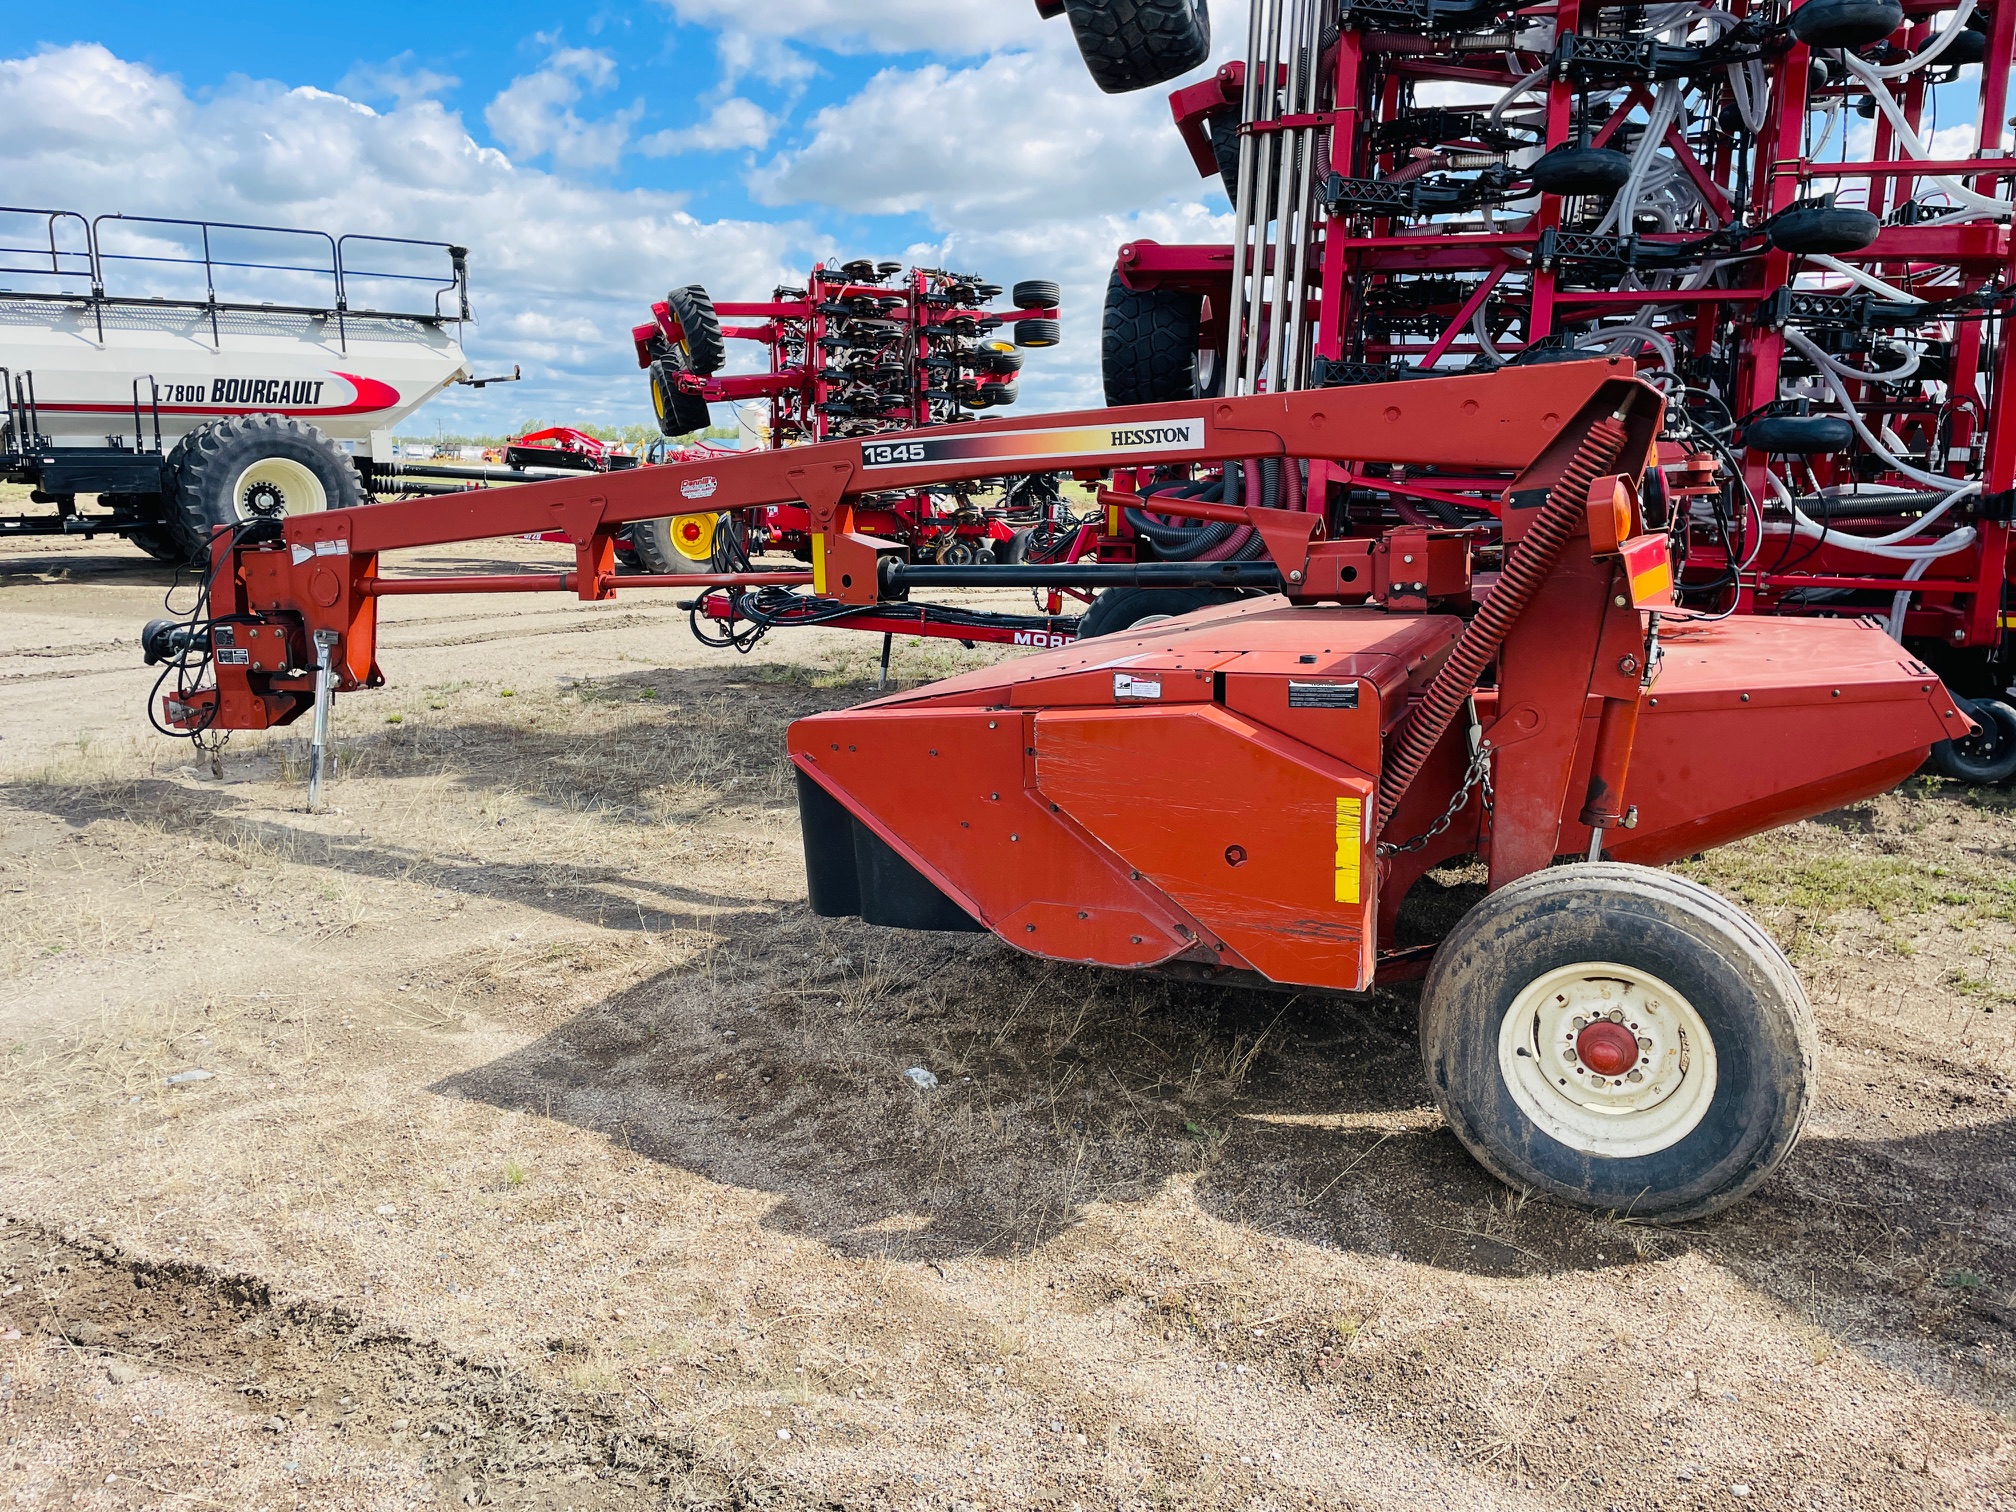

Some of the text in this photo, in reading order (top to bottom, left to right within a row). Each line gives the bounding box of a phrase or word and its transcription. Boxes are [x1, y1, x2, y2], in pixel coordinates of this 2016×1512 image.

[211, 378, 324, 404] BOURGAULT
[864, 427, 1190, 463] 1345 HESSTON
